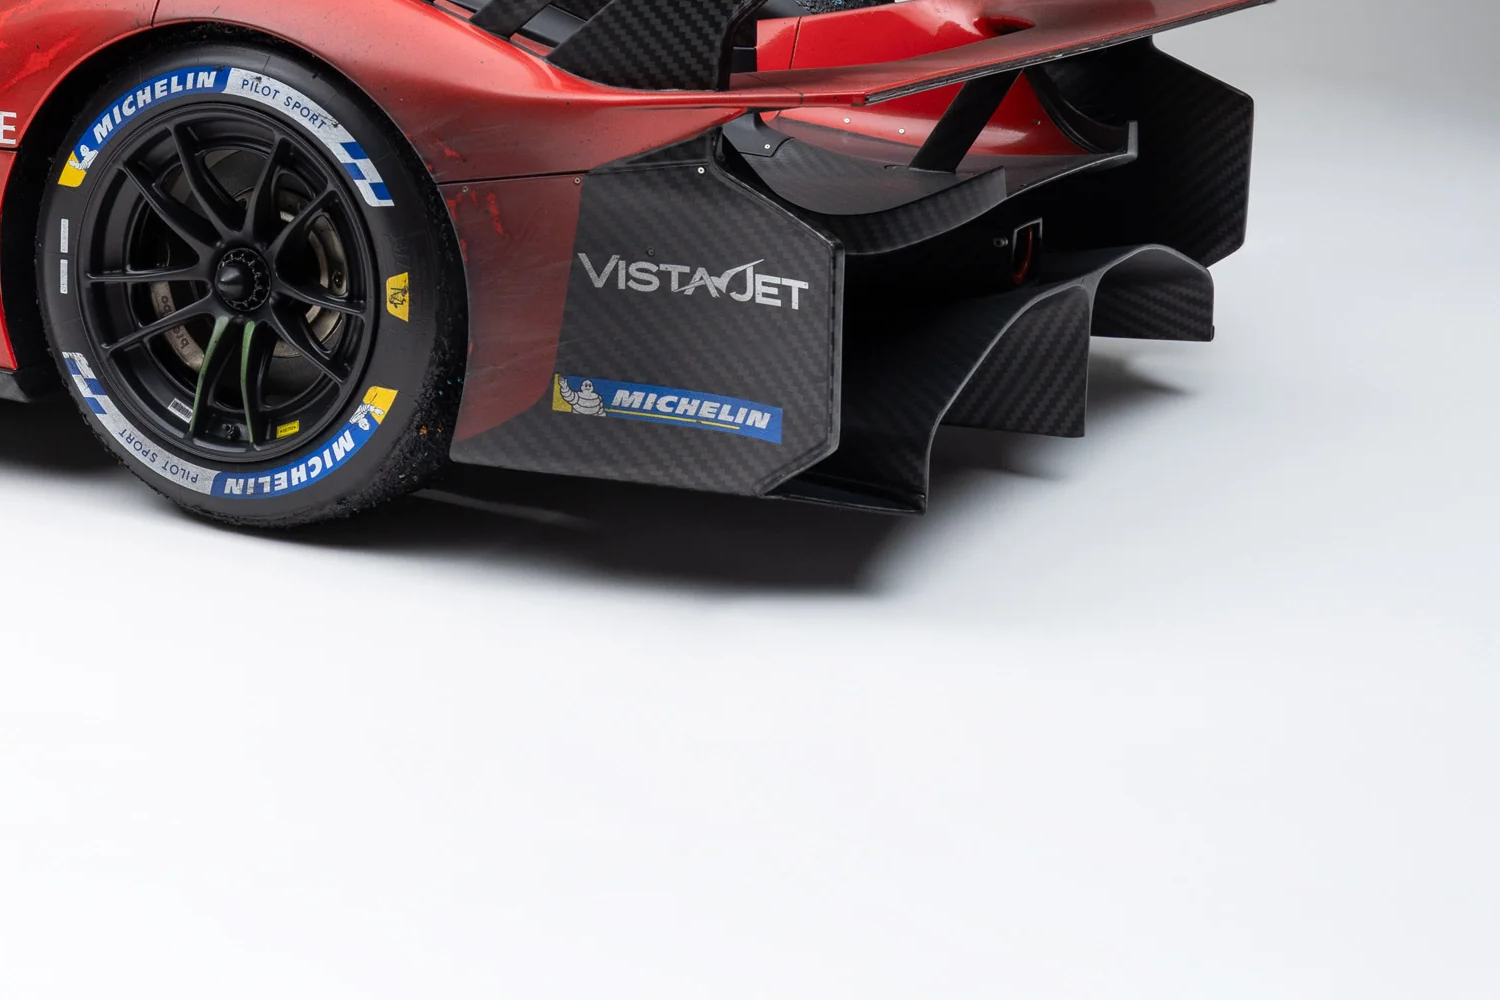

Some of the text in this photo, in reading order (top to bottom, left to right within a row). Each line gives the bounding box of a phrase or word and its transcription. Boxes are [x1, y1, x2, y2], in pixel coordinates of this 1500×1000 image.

[93, 71, 218, 144] MICHELIN
[240, 79, 328, 130] PILOT SPORT
[577, 252, 809, 311] VISTAJET
[611, 389, 771, 430] MICHELIN
[117, 427, 199, 484] PILOT SPORT
[224, 429, 356, 496] MICHELIN
